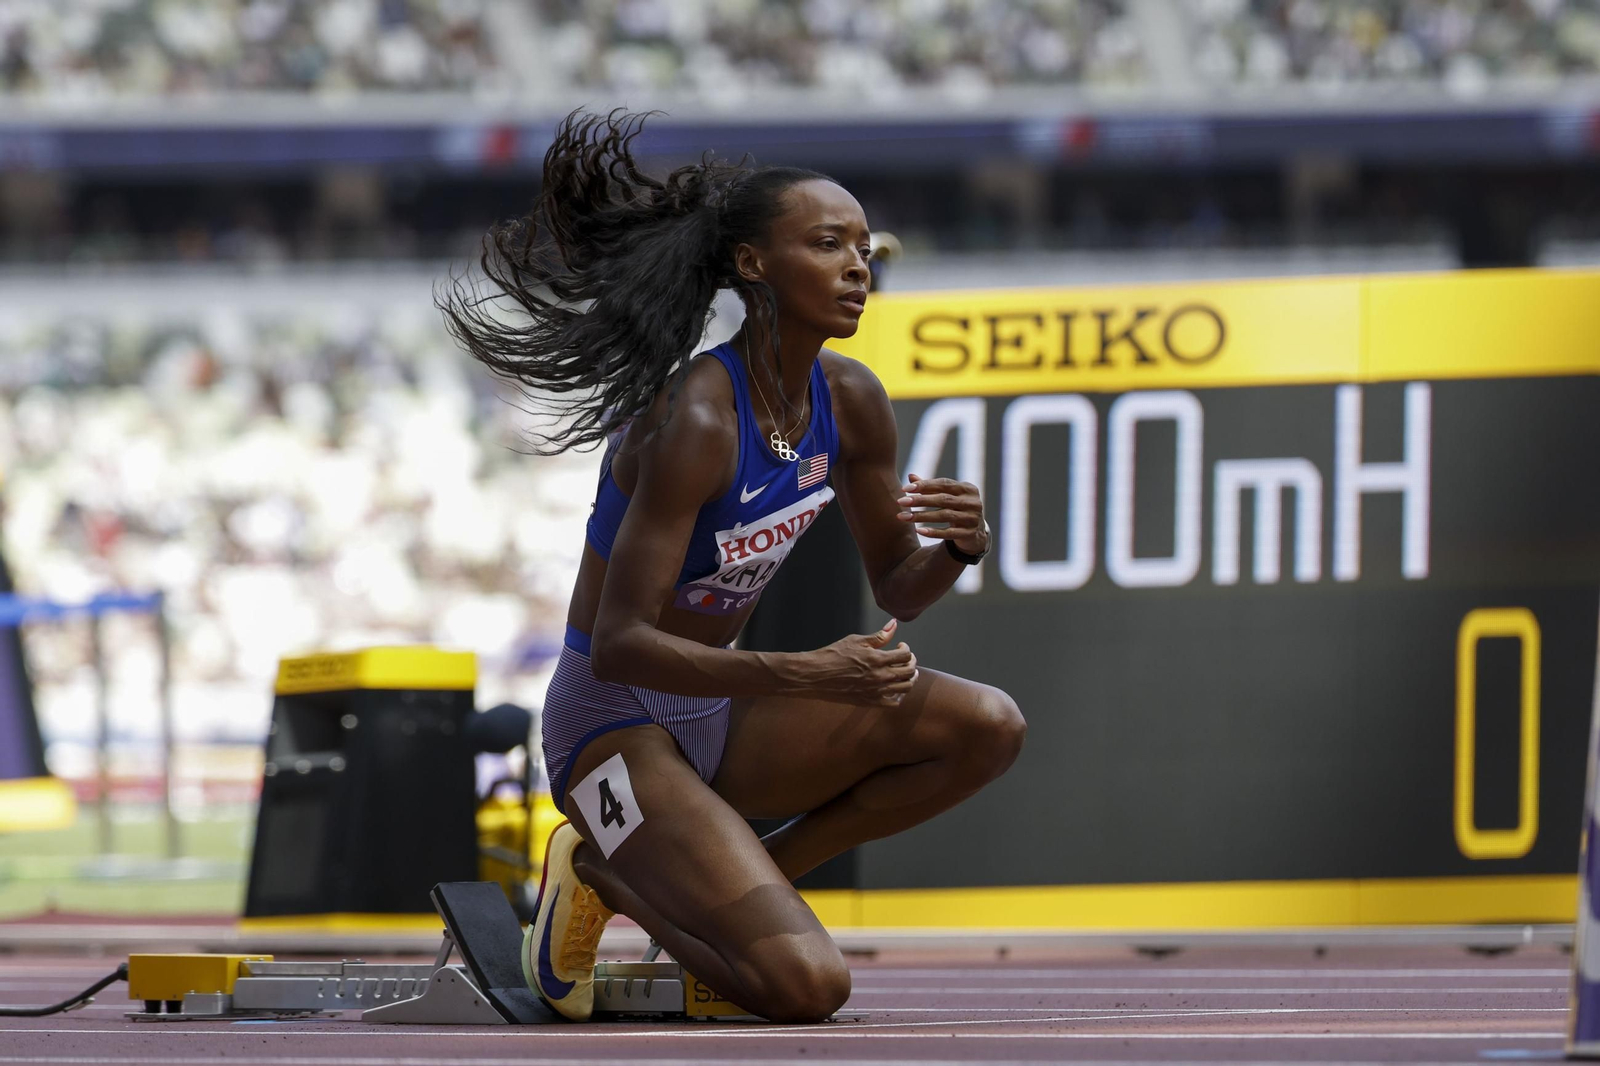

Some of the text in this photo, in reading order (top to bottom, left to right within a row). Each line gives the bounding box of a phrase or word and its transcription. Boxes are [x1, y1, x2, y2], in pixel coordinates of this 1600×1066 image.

[911, 302, 1227, 374] SEIKO
[902, 382, 1433, 594] 400mH
[598, 777, 626, 829] 4
[1453, 606, 1541, 860] 0
